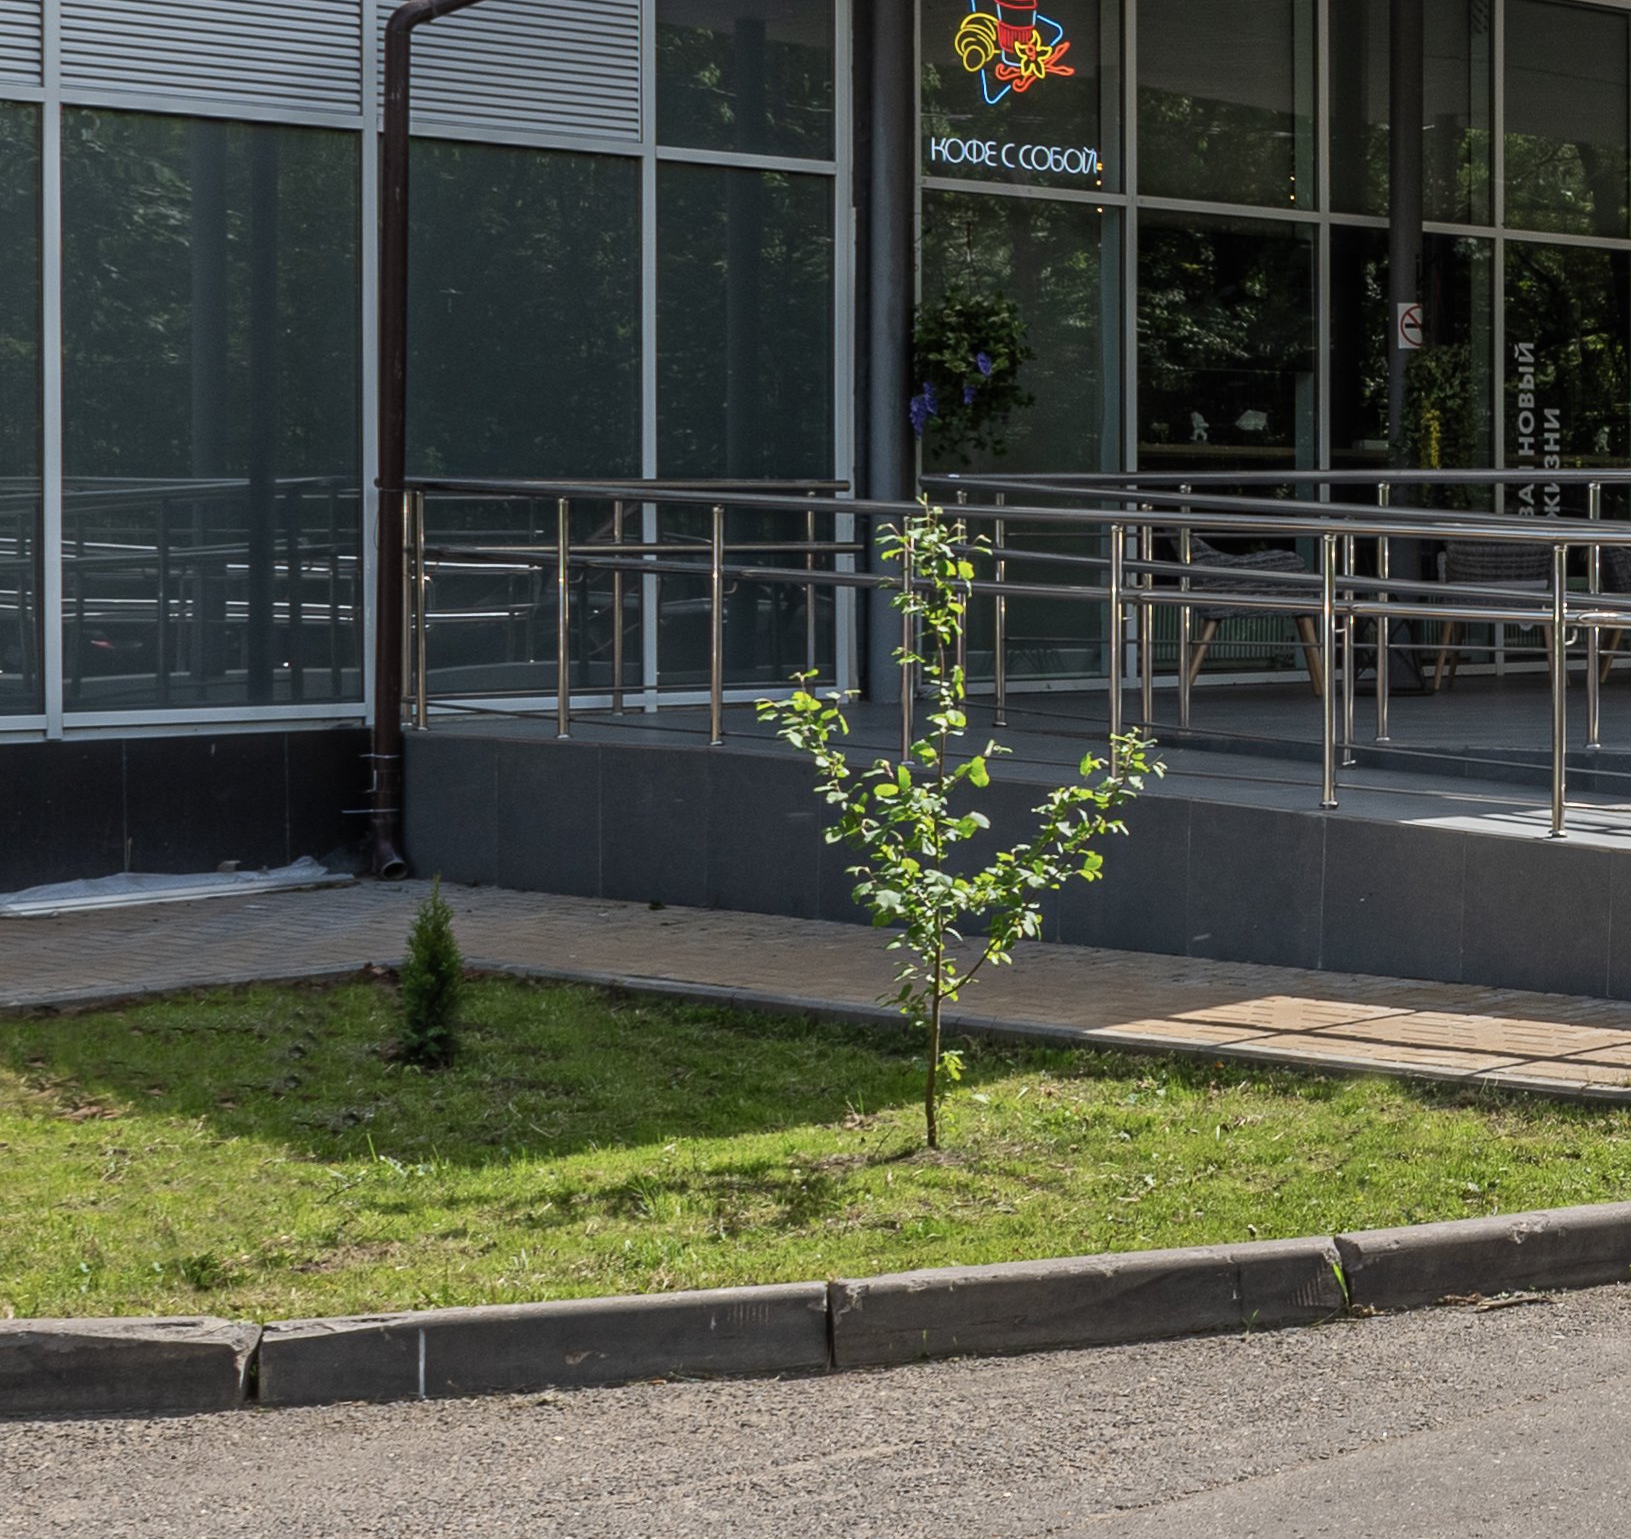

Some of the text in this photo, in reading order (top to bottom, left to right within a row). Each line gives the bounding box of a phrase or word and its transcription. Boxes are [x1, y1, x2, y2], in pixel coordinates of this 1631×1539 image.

[931, 137, 1098, 174] КОФЕ С СОБОЙ
[1514, 342, 1535, 456] НОВЫЙ
